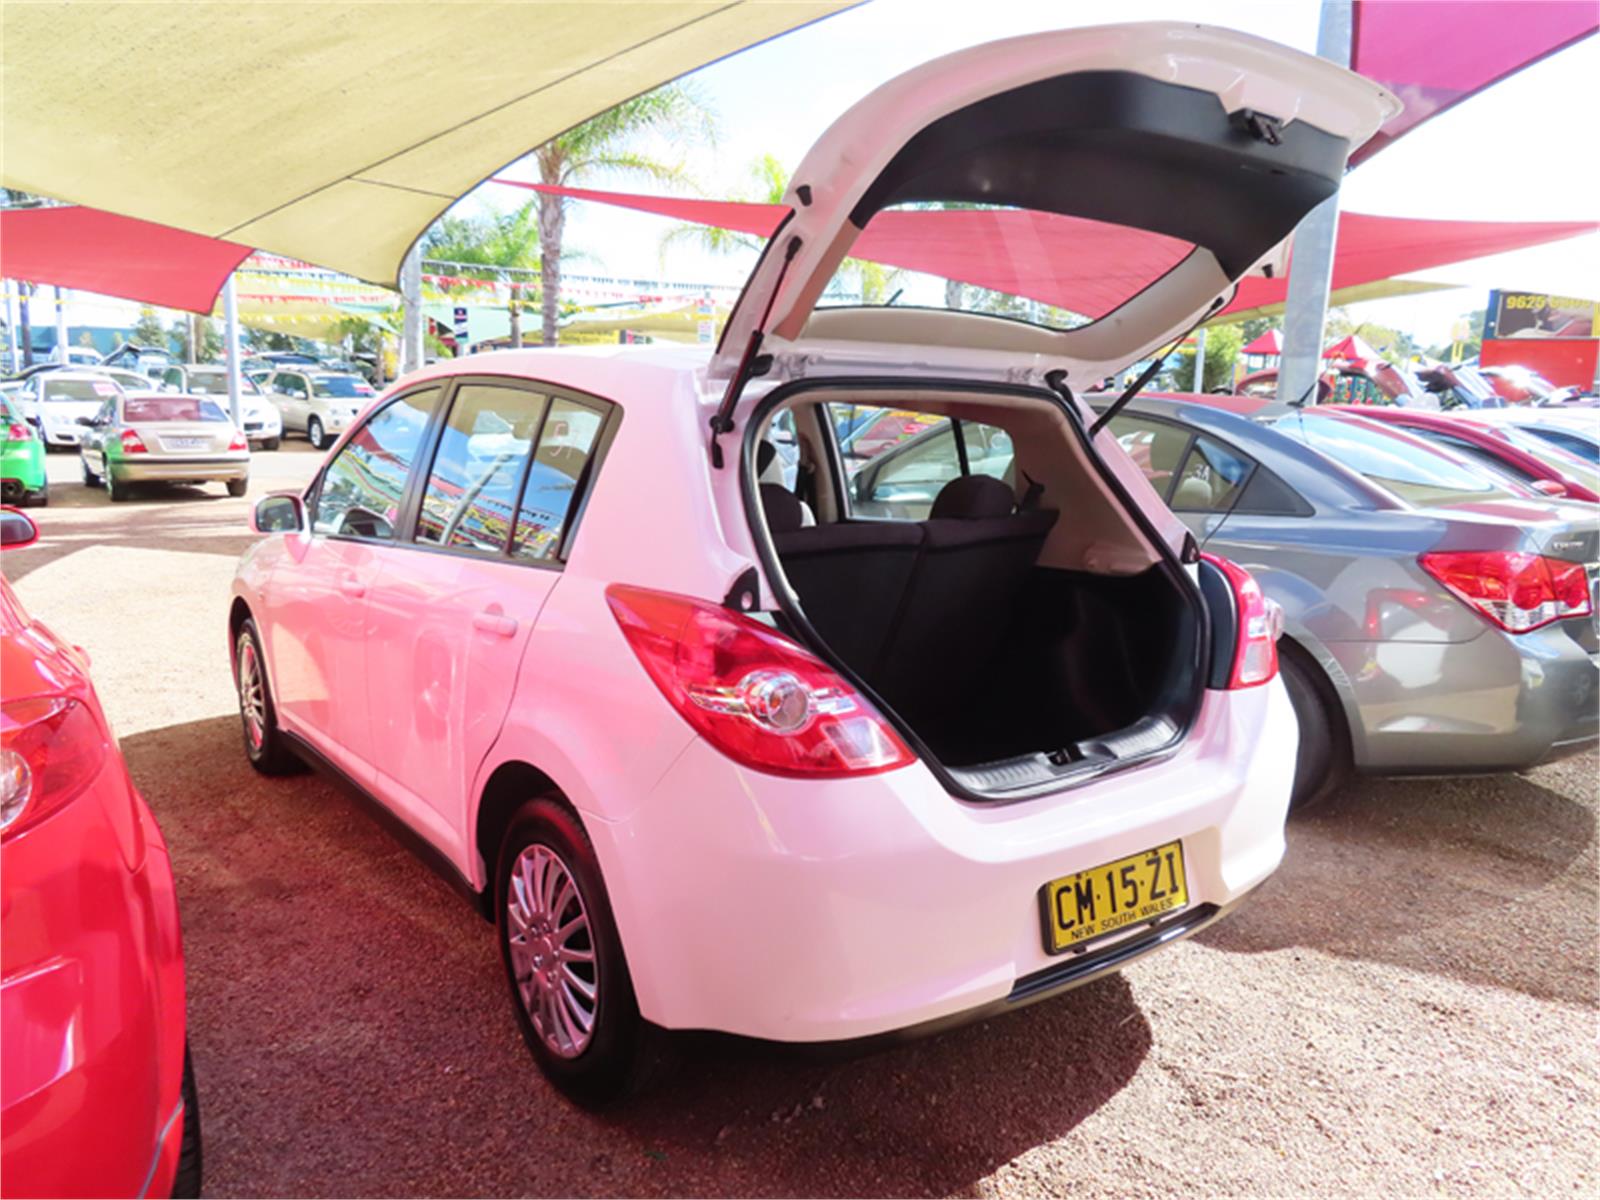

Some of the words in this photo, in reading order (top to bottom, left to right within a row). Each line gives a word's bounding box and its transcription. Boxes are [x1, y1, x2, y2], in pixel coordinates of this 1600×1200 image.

[1506, 295, 1546, 310] 9625
[1072, 927, 1095, 940] NEW
[1101, 911, 1137, 931] SOUTH
[1140, 897, 1174, 916] WALES
